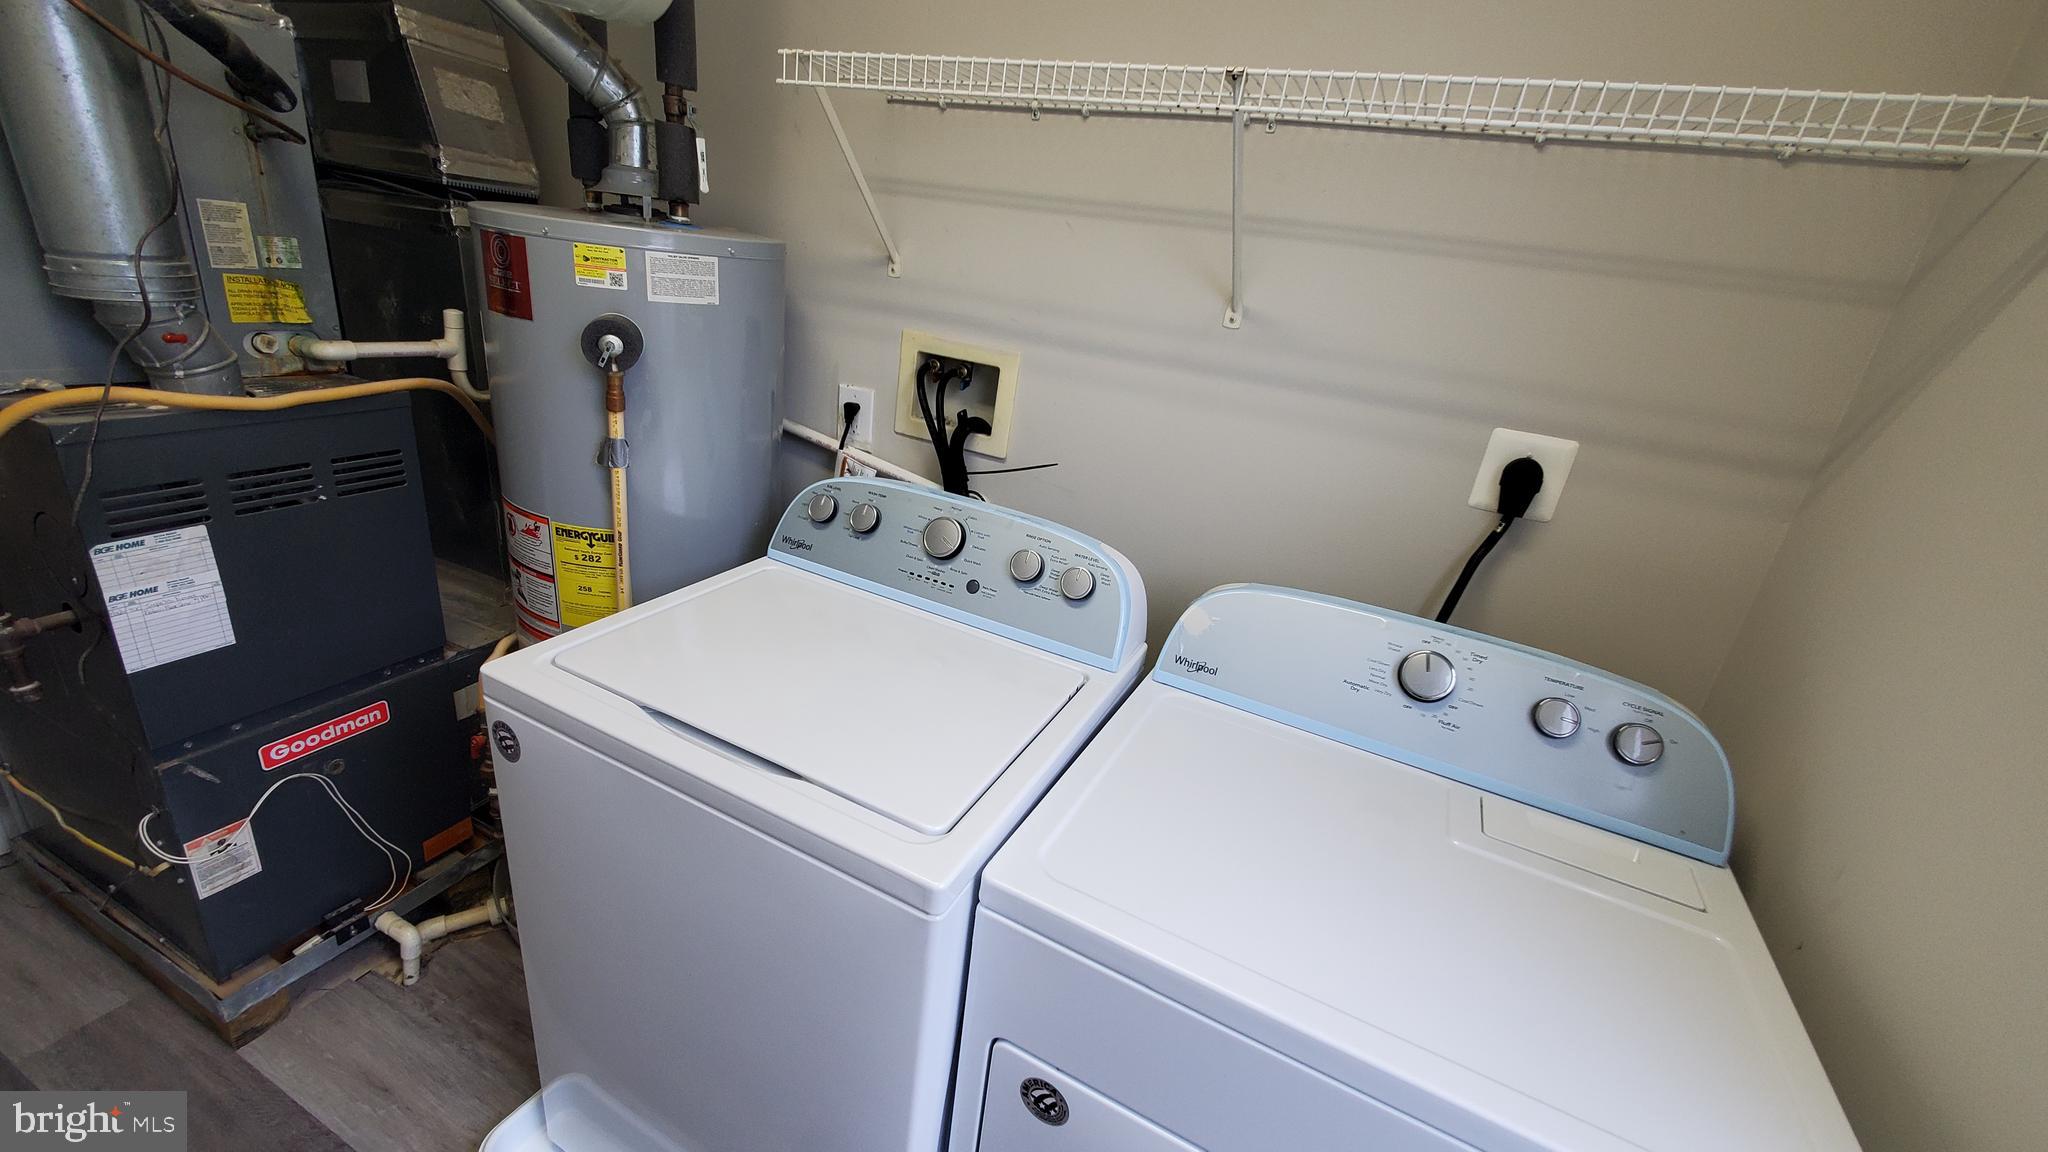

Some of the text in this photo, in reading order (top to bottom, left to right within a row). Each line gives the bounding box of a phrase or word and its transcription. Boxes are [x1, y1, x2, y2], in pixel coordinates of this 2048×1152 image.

[94, 540, 145, 556] BGE HOME
[782, 535, 814, 551] Whirlpool
[582, 554, 602, 563] 282
[109, 586, 159, 603] BGE HOME
[1175, 655, 1218, 676] Whirlpool
[1343, 680, 1370, 690] Automatic
[1545, 676, 1585, 691] TEMPERATURE
[1623, 702, 1642, 710] CYCLE
[1643, 707, 1664, 717] SIGNAL
[269, 709, 382, 760] Goodman
